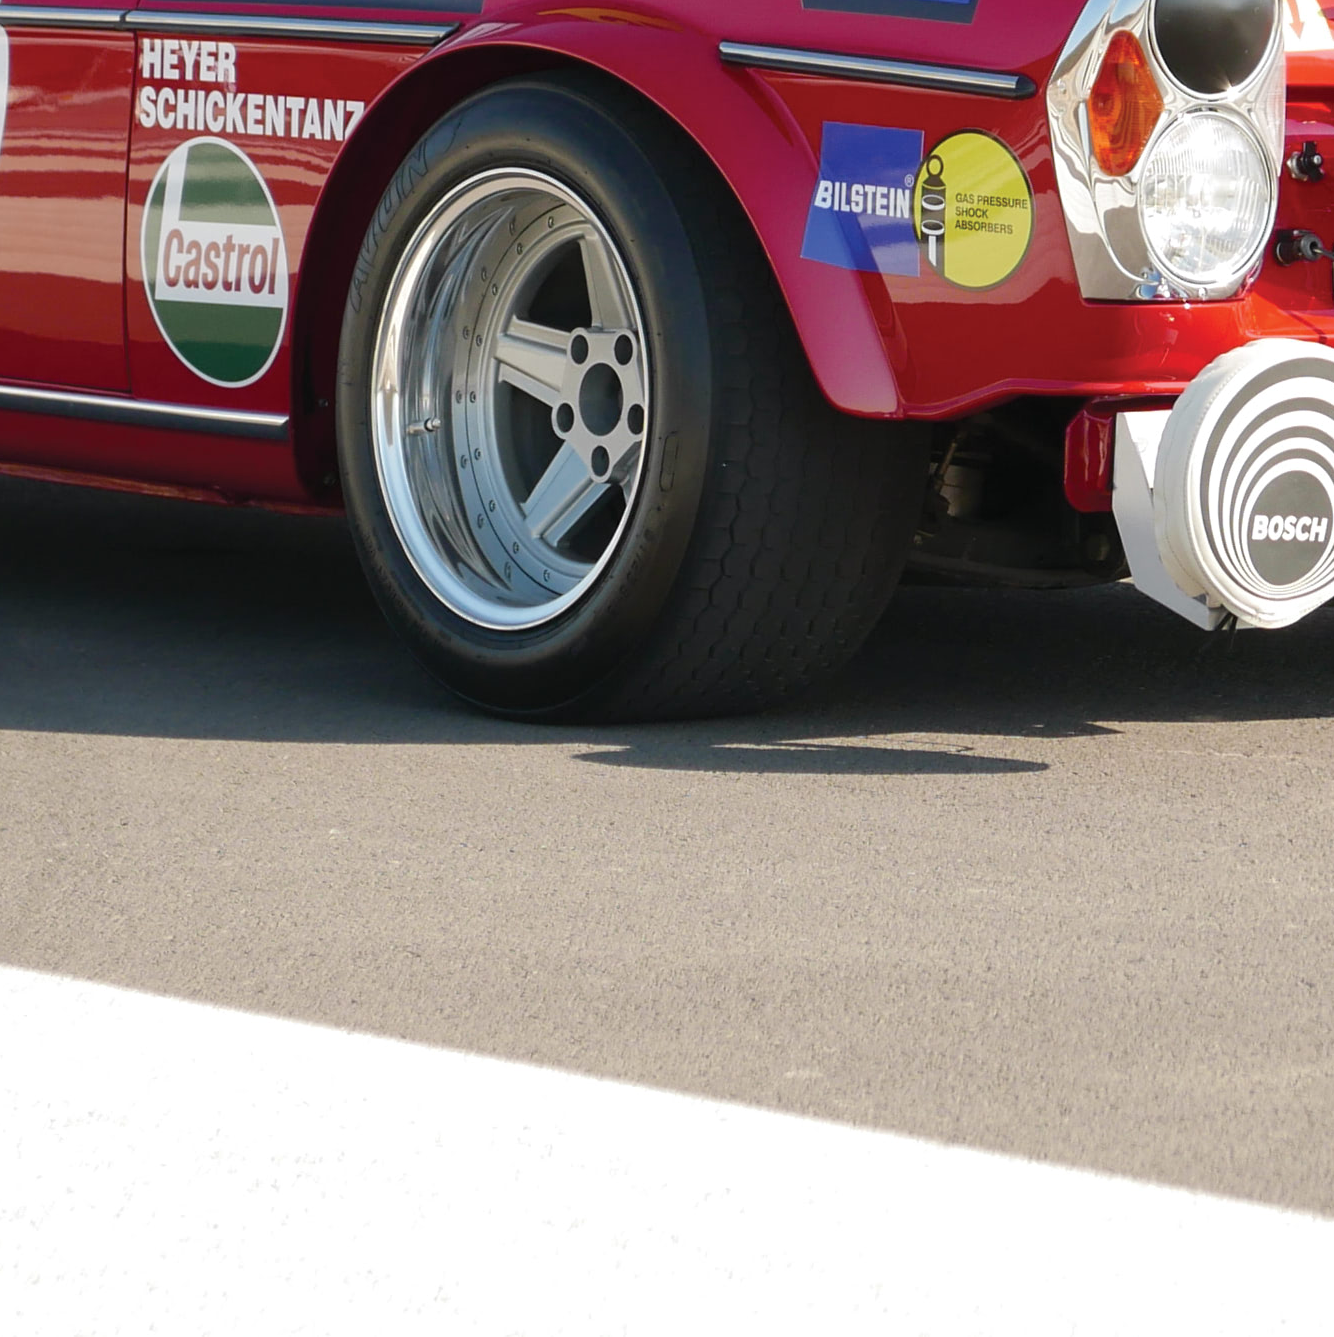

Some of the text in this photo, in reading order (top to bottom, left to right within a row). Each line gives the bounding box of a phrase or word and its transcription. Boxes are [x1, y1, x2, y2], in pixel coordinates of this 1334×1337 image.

[142, 38, 236, 83] HEYER
[814, 179, 910, 219] BILSTEIN
[955, 192, 1028, 210] GAS PRESSURE
[955, 206, 989, 219] SHOCK
[955, 219, 1013, 235] ABSORBERS
[162, 228, 280, 295] Castrol
[1251, 514, 1328, 543] BOSCH
